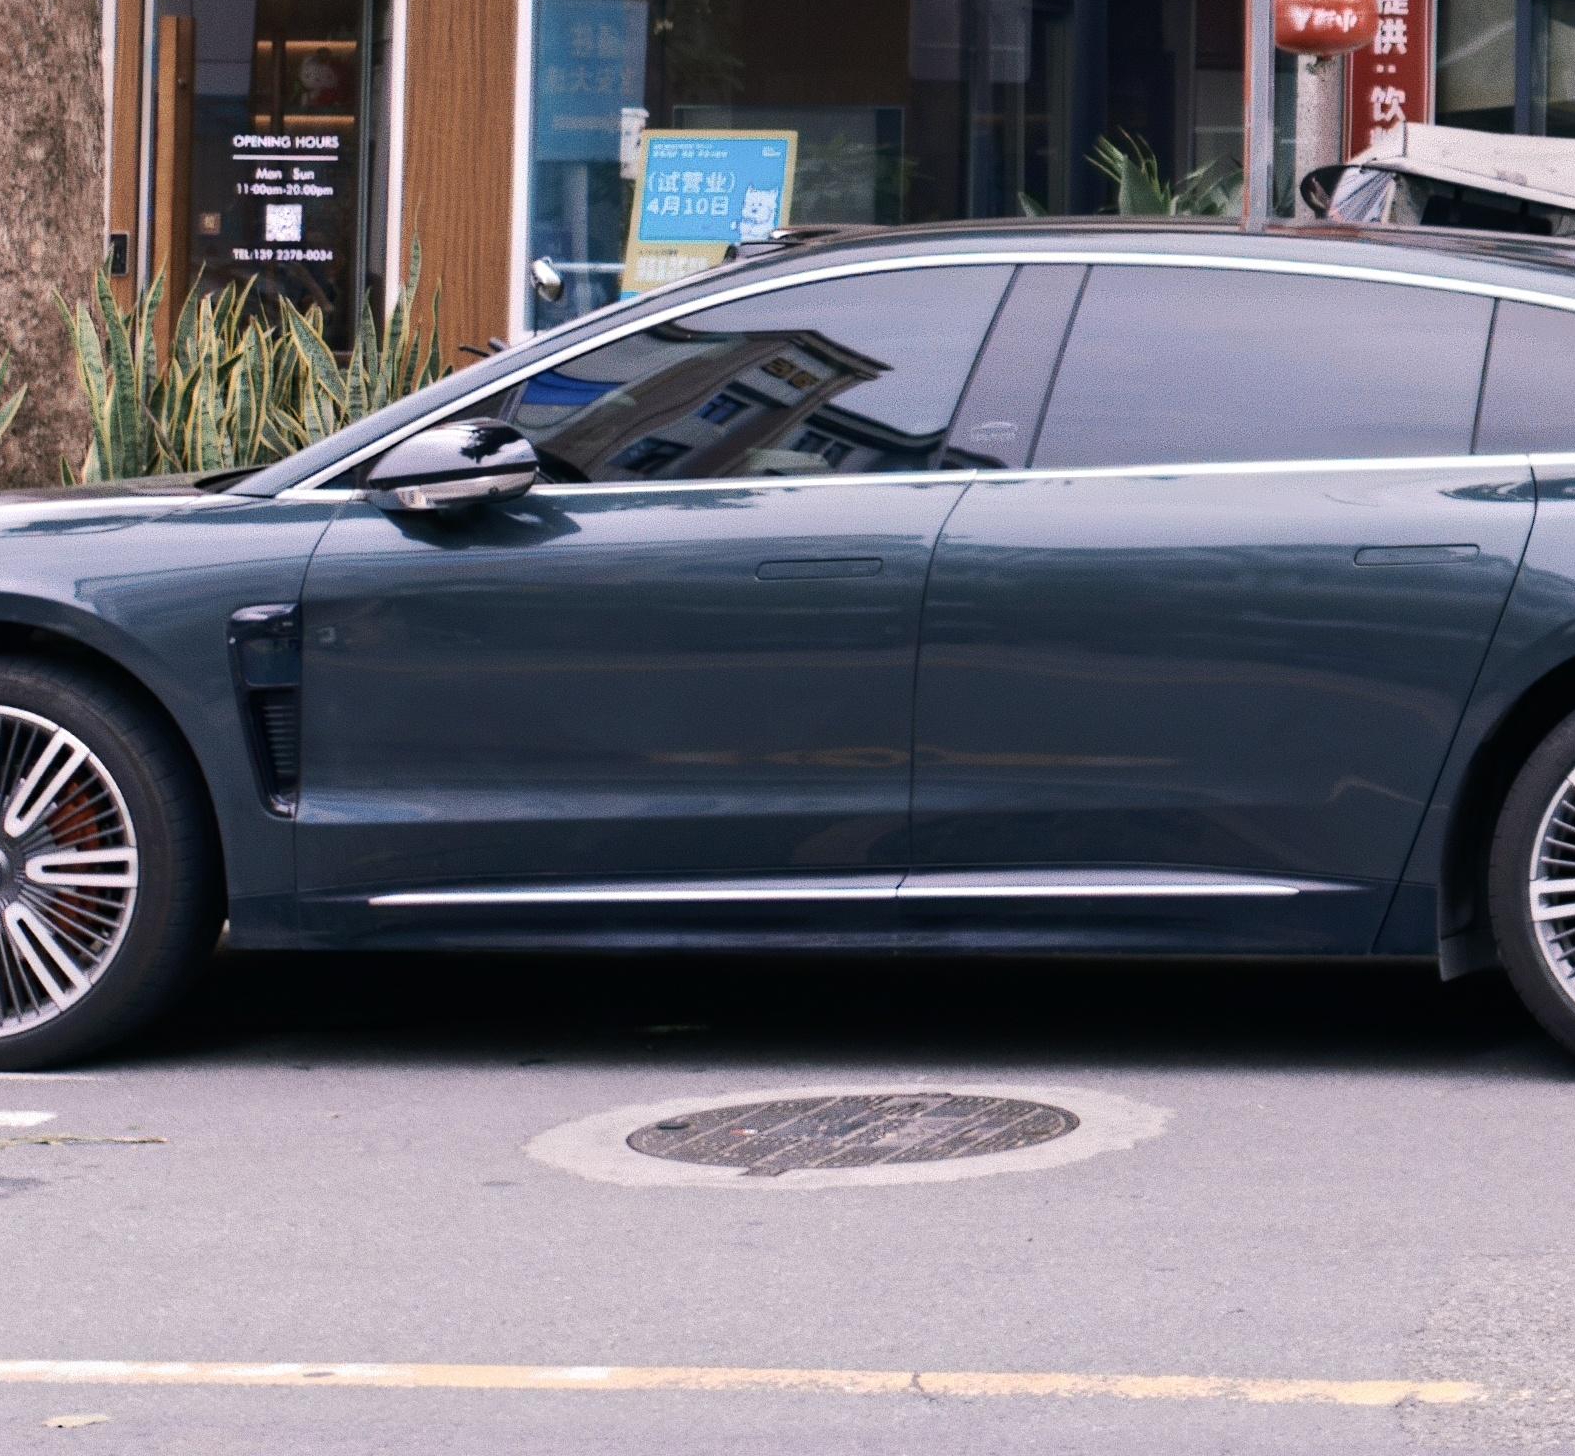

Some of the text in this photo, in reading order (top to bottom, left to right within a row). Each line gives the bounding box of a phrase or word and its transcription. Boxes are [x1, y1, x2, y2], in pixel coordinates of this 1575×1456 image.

[232, 135, 339, 149] OPENING HOURS
[292, 167, 315, 180] Sun
[646, 195, 729, 217] 4月10日
